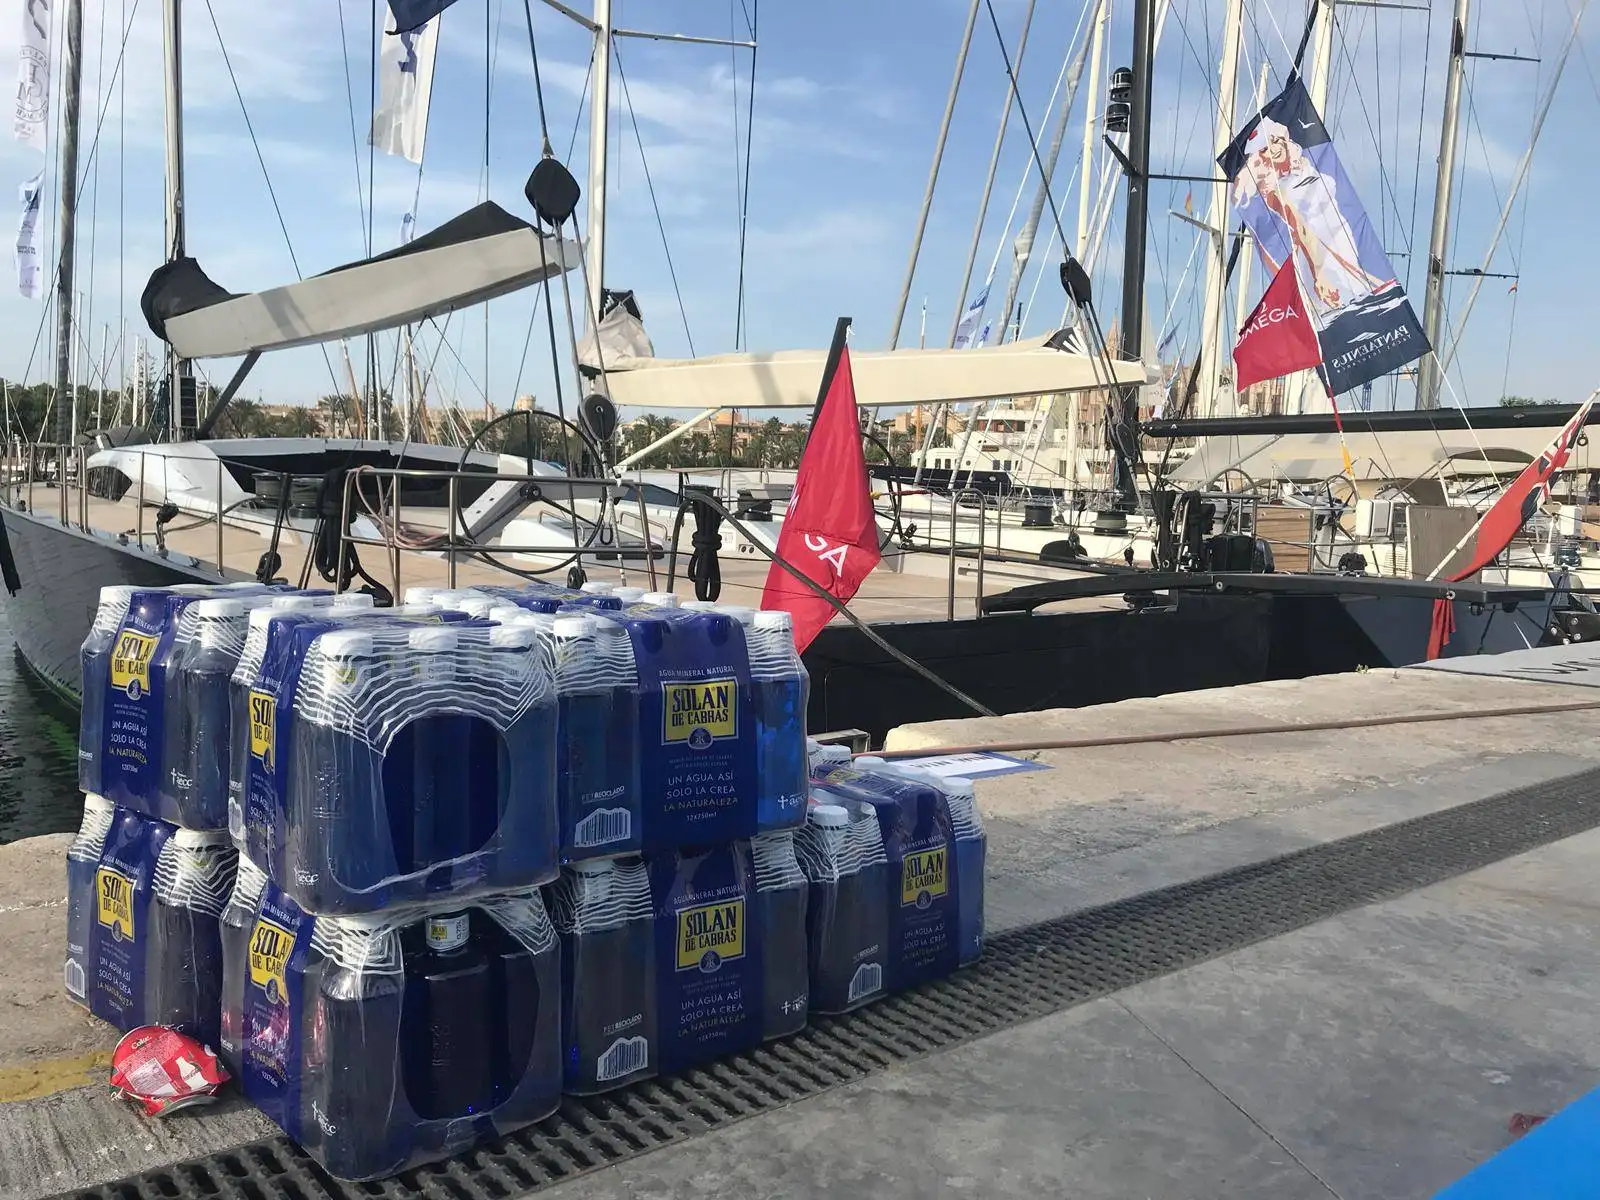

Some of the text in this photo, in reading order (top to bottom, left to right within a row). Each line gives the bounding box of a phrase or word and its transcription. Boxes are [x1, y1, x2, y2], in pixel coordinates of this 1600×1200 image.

[114, 659, 125, 673] DE
[659, 664, 736, 677] AGUA MINERAL NATURAL
[111, 720, 121, 729] UN
[122, 721, 140, 733] AGUA
[671, 709, 729, 727] DE CABRAS
[110, 733, 127, 744] SOLO
[128, 735, 135, 744] LA
[668, 770, 734, 786] UN AGUA ASÍ
[666, 785, 736, 799] SOLO LA CREA
[664, 797, 739, 812] LA NATURALEZA
[915, 871, 943, 889] CABRAS
[270, 904, 292, 924] MINERAL
[685, 929, 737, 952] DE CABRAS
[681, 988, 742, 1011] UN AGUA ASÍ
[680, 1004, 743, 1024] SOLO LA CREA
[691, 1013, 746, 1031] NATURALEZA
